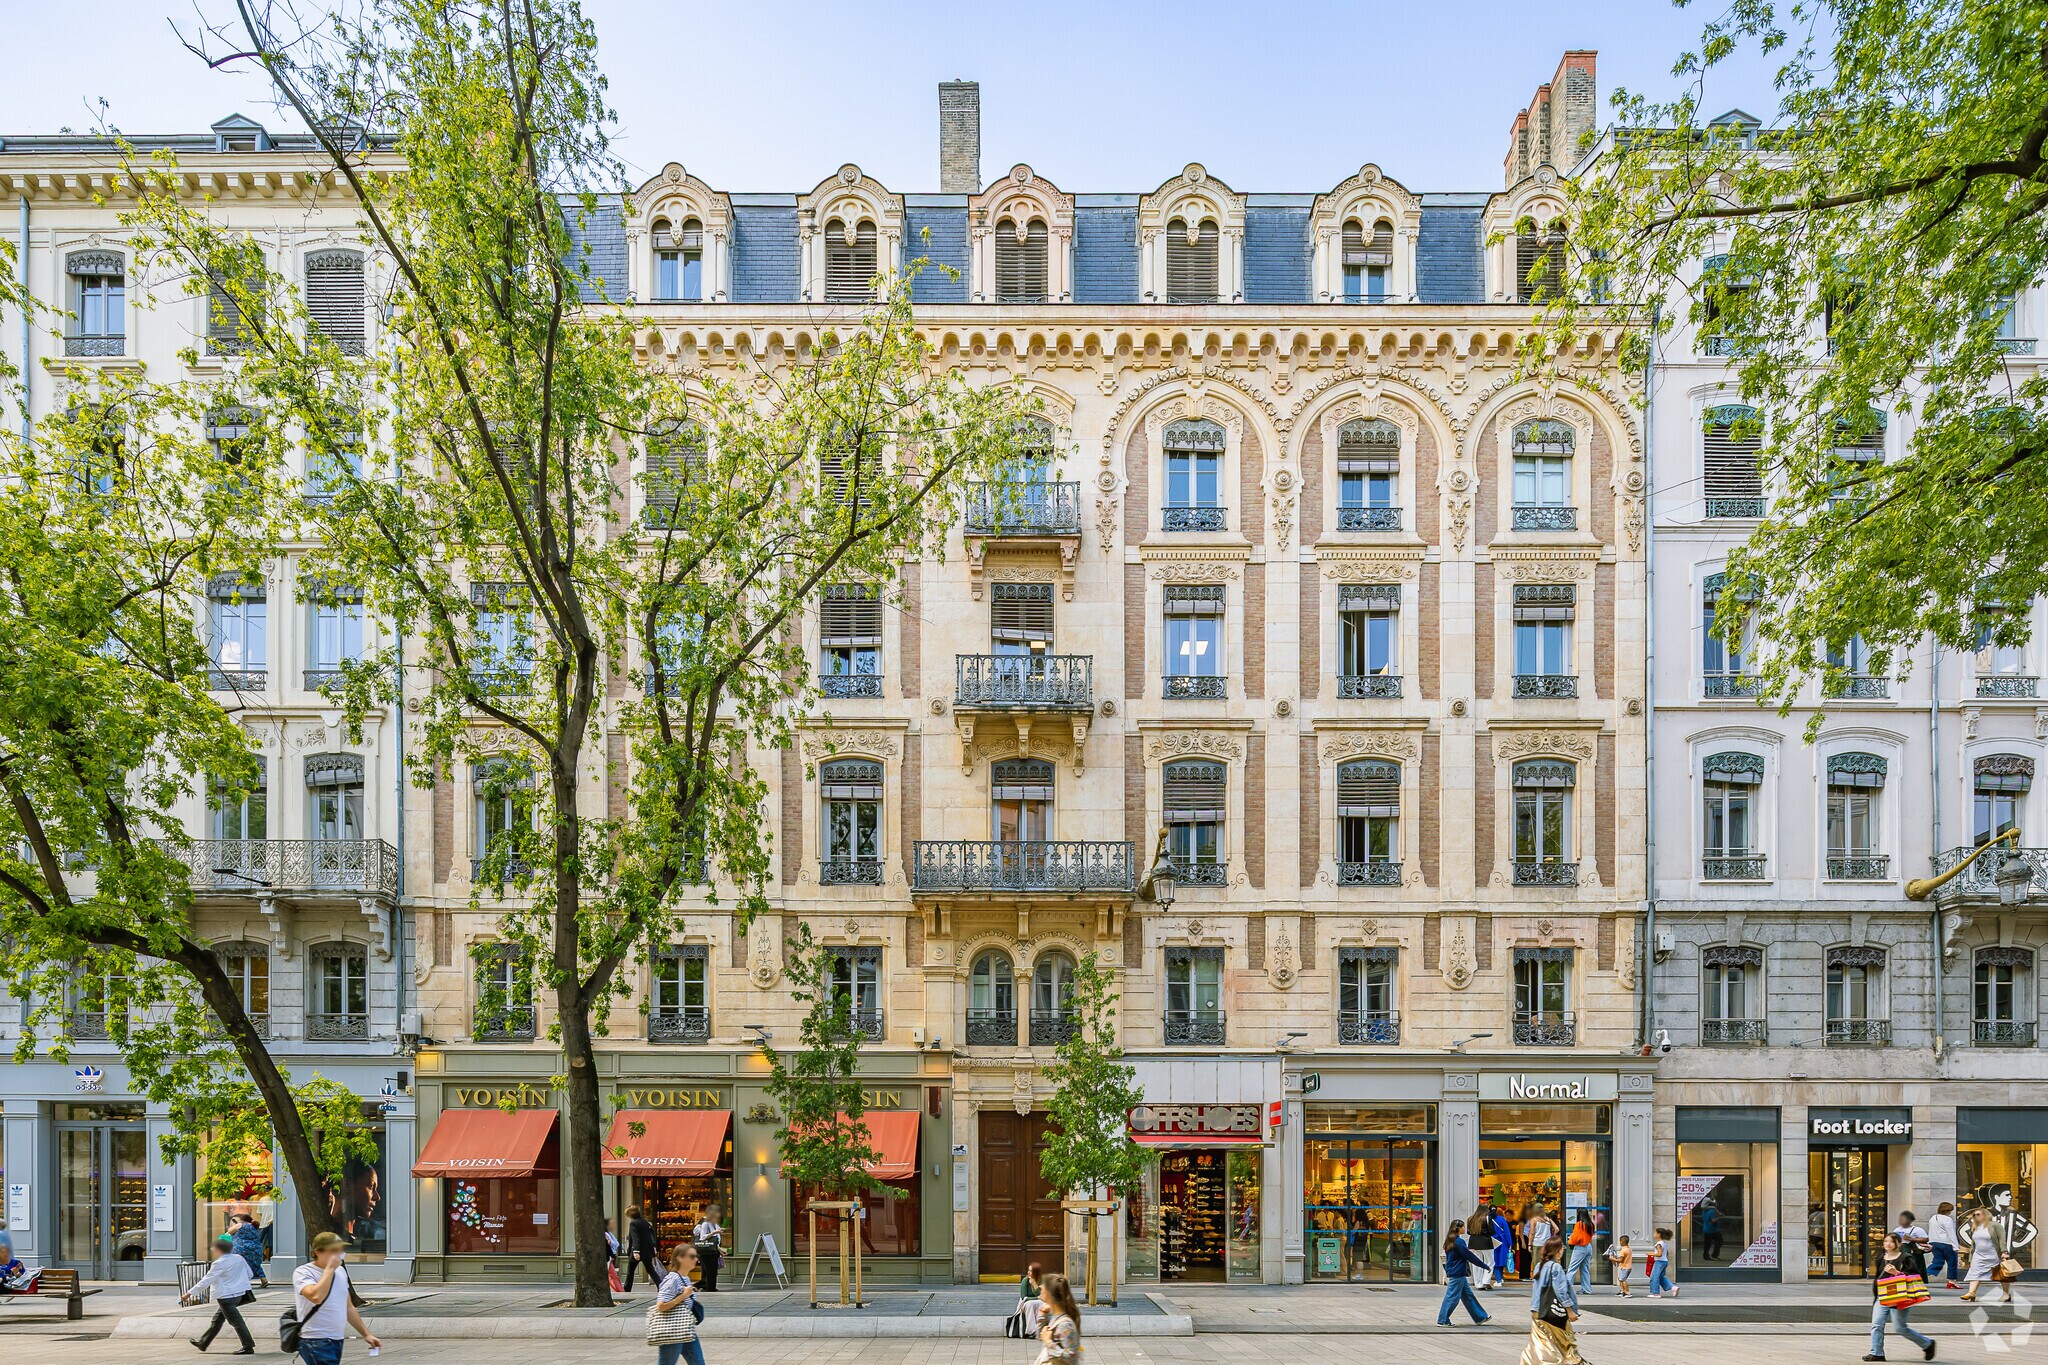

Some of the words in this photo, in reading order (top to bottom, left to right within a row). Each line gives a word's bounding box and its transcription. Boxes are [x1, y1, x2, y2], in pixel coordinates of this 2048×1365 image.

[75, 1083, 103, 1091] adidas
[1509, 1073, 1590, 1099] Normal
[455, 1088, 548, 1106] VOISIN
[629, 1089, 720, 1107] VOISIN
[378, 1103, 398, 1112] adidas
[1129, 1106, 1260, 1132] OFFSHOES
[1813, 1118, 1850, 1134] Foot
[1855, 1118, 1912, 1134] Locker
[449, 1158, 506, 1167] VOISIN
[630, 1156, 688, 1165] VOISIN
[1677, 1183, 1705, 1193] -20%
[1749, 1254, 1777, 1264] -20%
